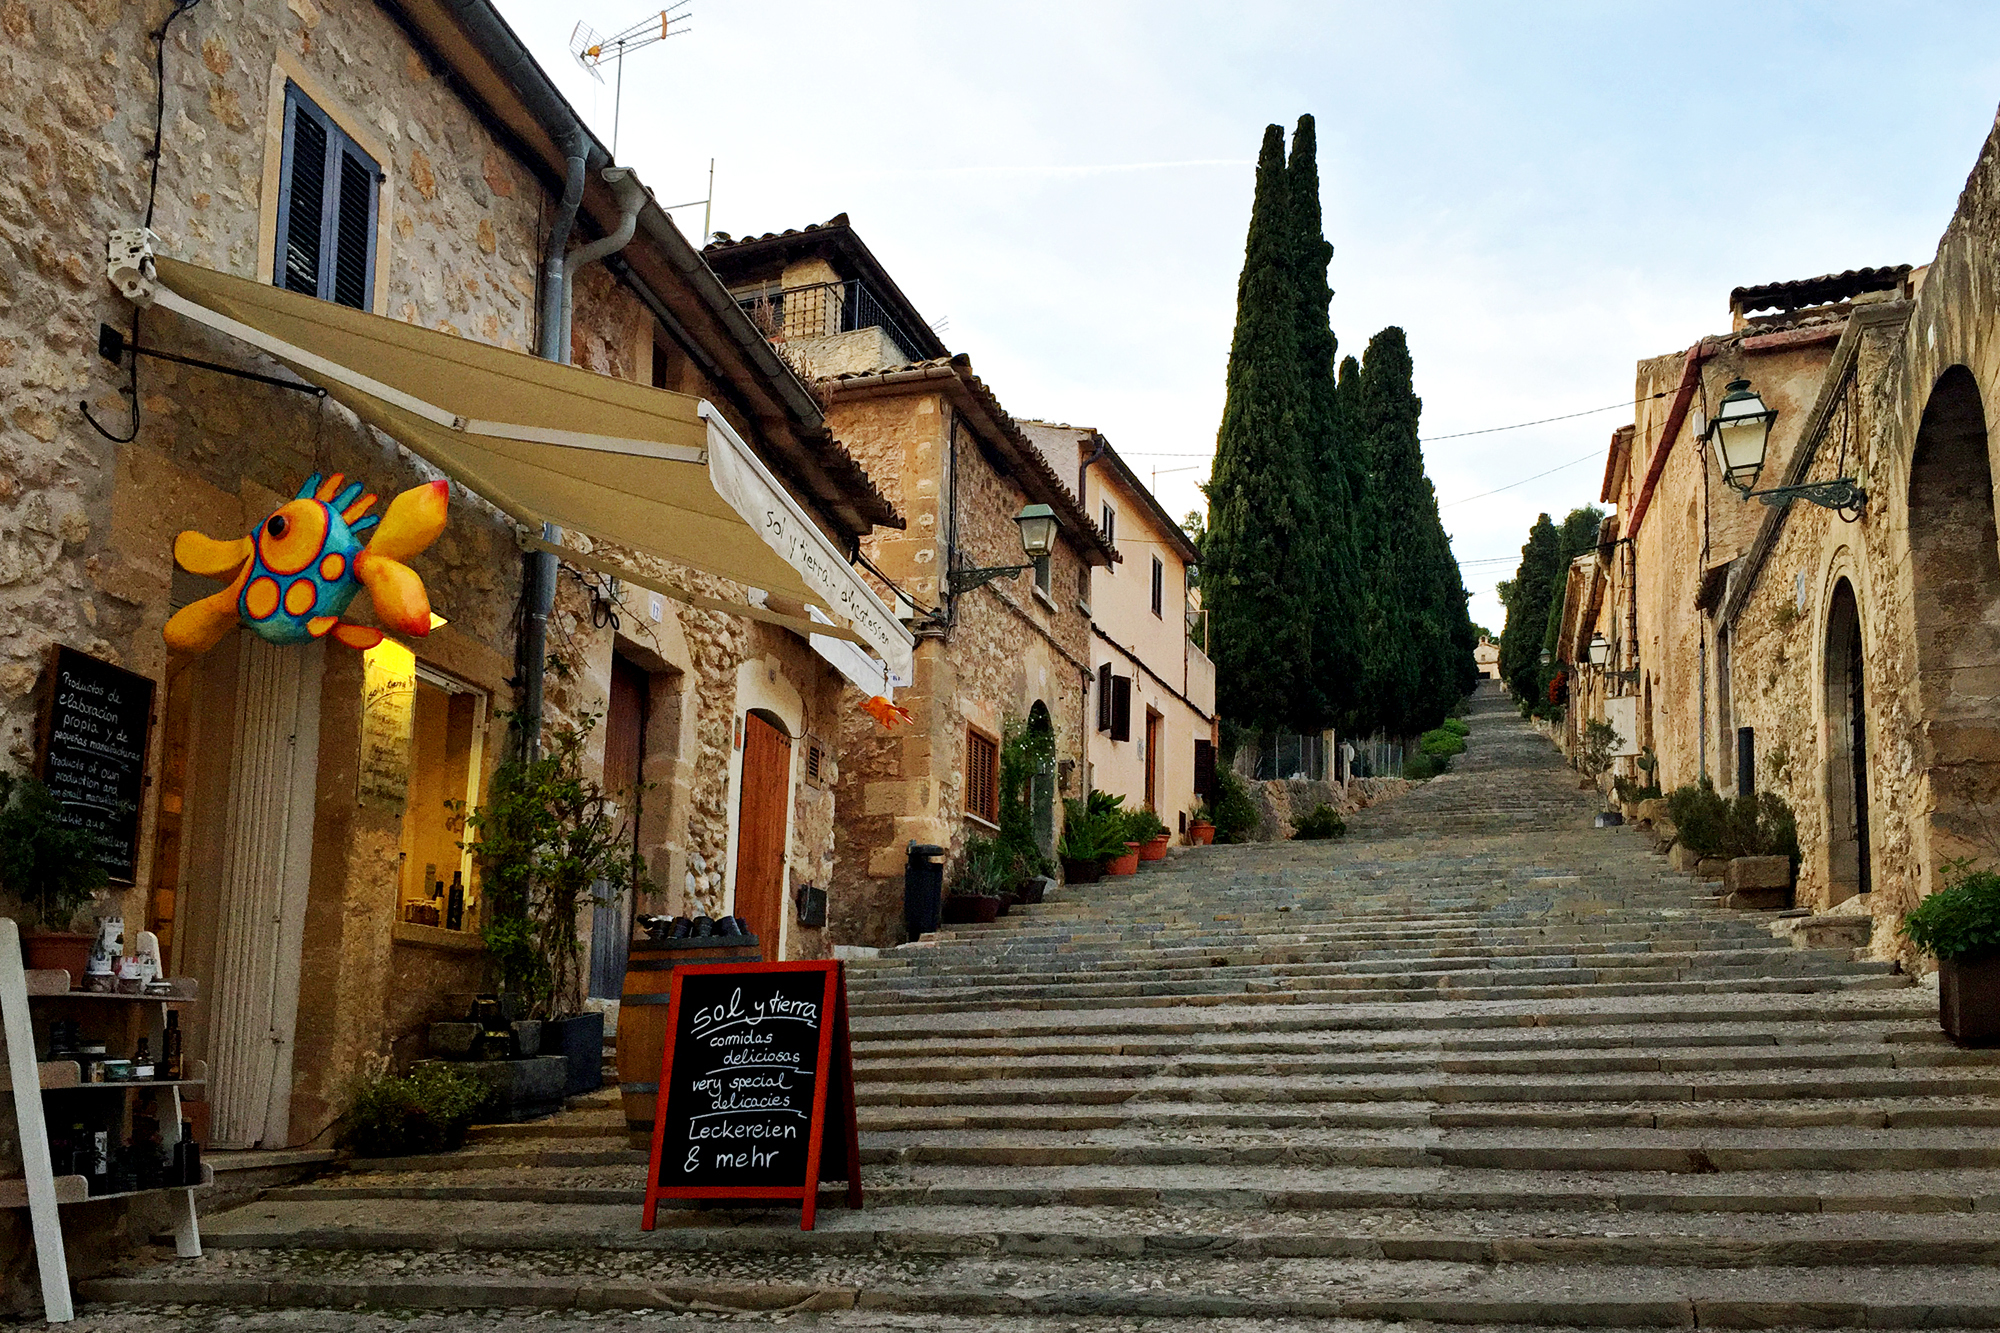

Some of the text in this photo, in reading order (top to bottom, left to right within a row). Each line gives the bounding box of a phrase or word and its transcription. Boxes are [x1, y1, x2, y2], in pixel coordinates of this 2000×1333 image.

[789, 535, 797, 559] y
[800, 540, 828, 587] tierra
[62, 671, 123, 704] Productos de
[63, 714, 128, 743] propia y de
[49, 751, 85, 771] Products
[88, 760, 99, 774] of
[55, 771, 118, 799] production and
[85, 818, 106, 830] aus
[745, 1001, 765, 1025] y
[769, 990, 817, 1019] tierra
[710, 1029, 773, 1047] comidas
[724, 1048, 800, 1065] deliciosas
[693, 1073, 793, 1097] very special
[712, 1092, 790, 1110] delicacies
[689, 1120, 796, 1140] Leckereien
[684, 1145, 779, 1172] & mehr
